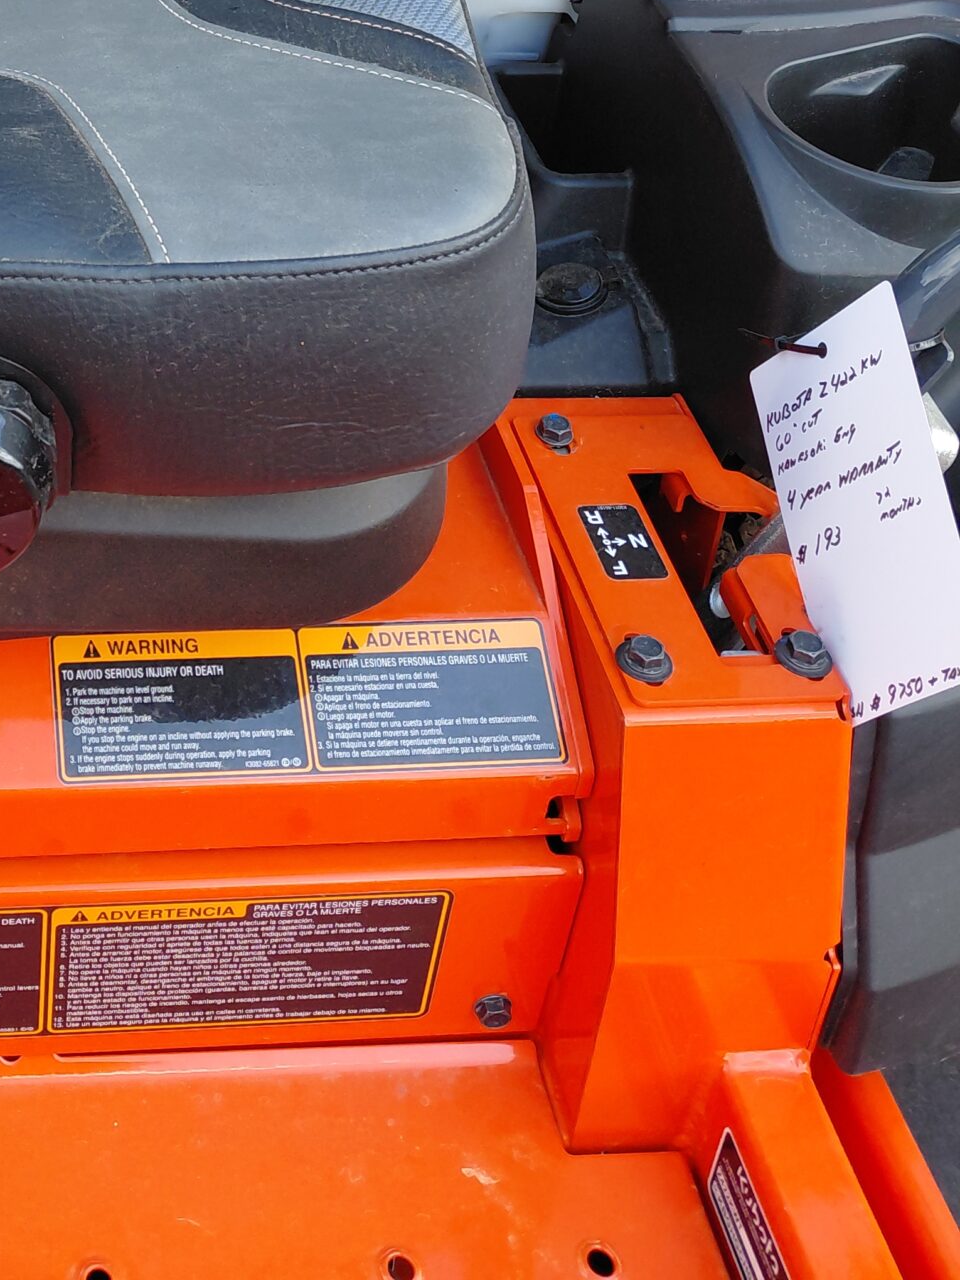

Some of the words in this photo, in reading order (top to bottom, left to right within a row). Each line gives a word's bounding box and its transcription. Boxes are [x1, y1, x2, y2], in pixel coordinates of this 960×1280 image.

[787, 489, 796, 511] 4
[584, 511, 604, 525] R
[627, 534, 648, 548] N
[815, 526, 840, 556] 193
[613, 561, 629, 575] F
[366, 629, 501, 648] ADVERTENCIA
[107, 639, 199, 655] WARNING
[311, 660, 332, 670] PARA
[332, 659, 359, 669] EVITAR
[360, 657, 397, 668] LESIONES
[398, 656, 447, 667] PERSONALES
[448, 655, 478, 665] GRAVES
[480, 654, 486, 664] O
[487, 654, 498, 664] LA
[498, 653, 529, 663] MUERTE
[62, 670, 74, 681] TO
[76, 669, 102, 680] AVOID
[105, 668, 144, 680] SERIOUS
[146, 667, 178, 678] INJURY
[180, 666, 193, 677] OR
[195, 665, 224, 676] DEATH
[73, 688, 87, 696] Park
[88, 687, 98, 696] the
[99, 687, 124, 695] machine
[135, 686, 149, 694] level
[151, 685, 175, 695] ground.
[254, 904, 280, 912] PARA
[320, 901, 368, 909] LESIONES
[371, 897, 438, 906] PERSONALES
[97, 907, 235, 920] ADVERTENCIA
[253, 910, 293, 918] GRAVES
[1, 918, 35, 926] DEATH
